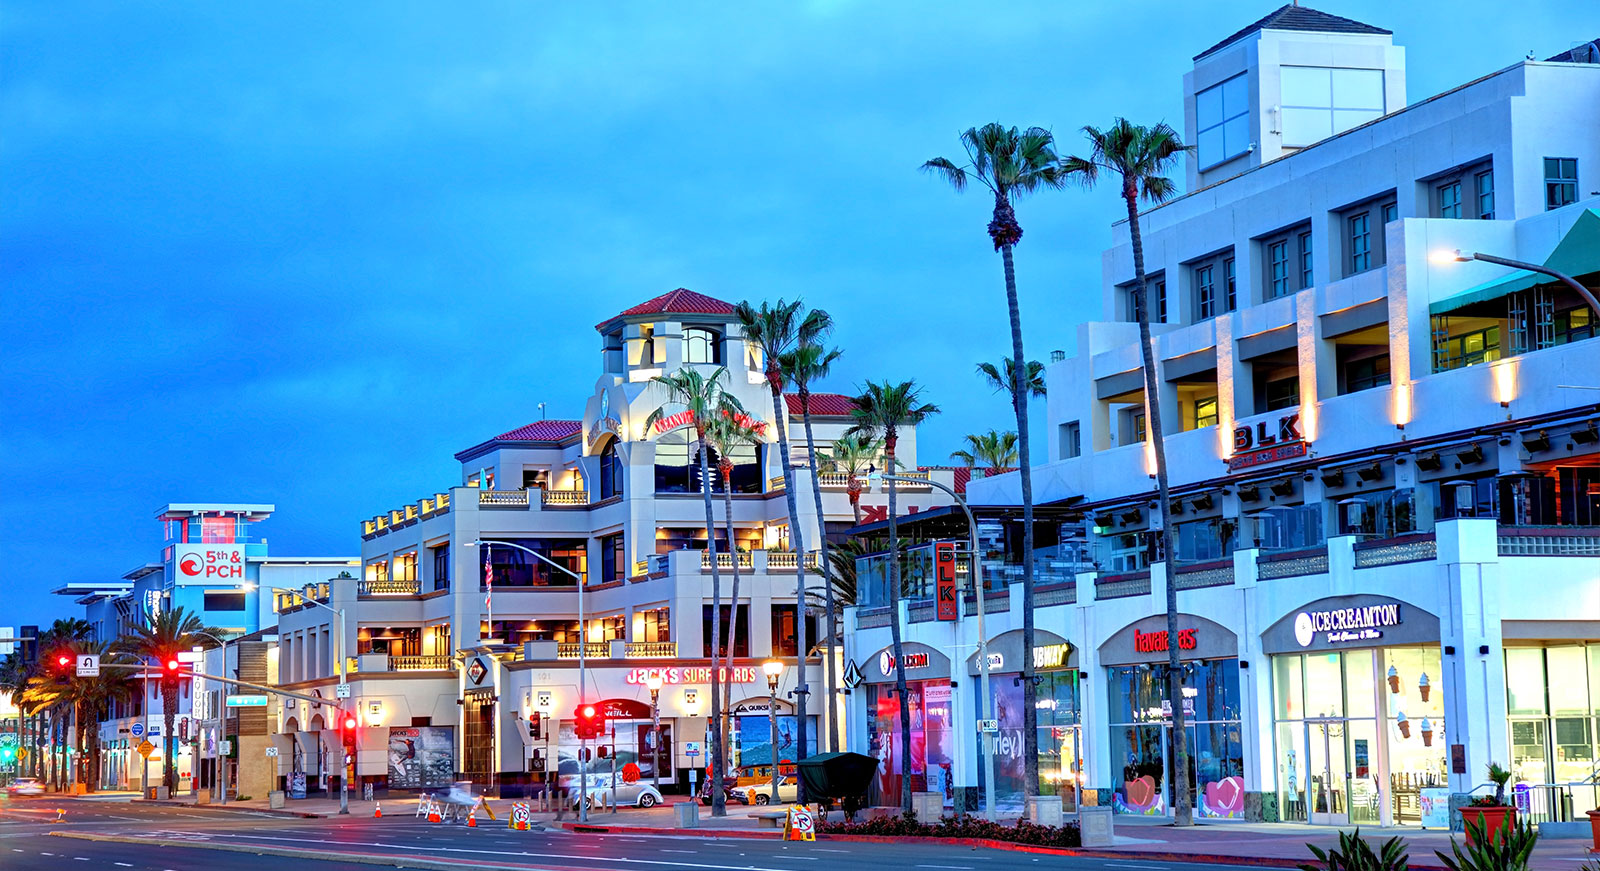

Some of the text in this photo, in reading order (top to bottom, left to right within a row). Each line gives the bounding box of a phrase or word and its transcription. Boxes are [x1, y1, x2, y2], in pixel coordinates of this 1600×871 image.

[654, 409, 695, 434] OCEANVIE
[1233, 414, 1300, 452] BLK
[206, 550, 242, 564] 5th &
[206, 565, 242, 578] PCH
[938, 546, 955, 602] BLK
[1311, 604, 1398, 632] ICECREAMTON
[1134, 629, 1197, 653] havaiaas
[889, 653, 929, 669] VLCOM
[1033, 643, 1069, 668] UBWAY
[684, 668, 756, 683] SURFORDS
